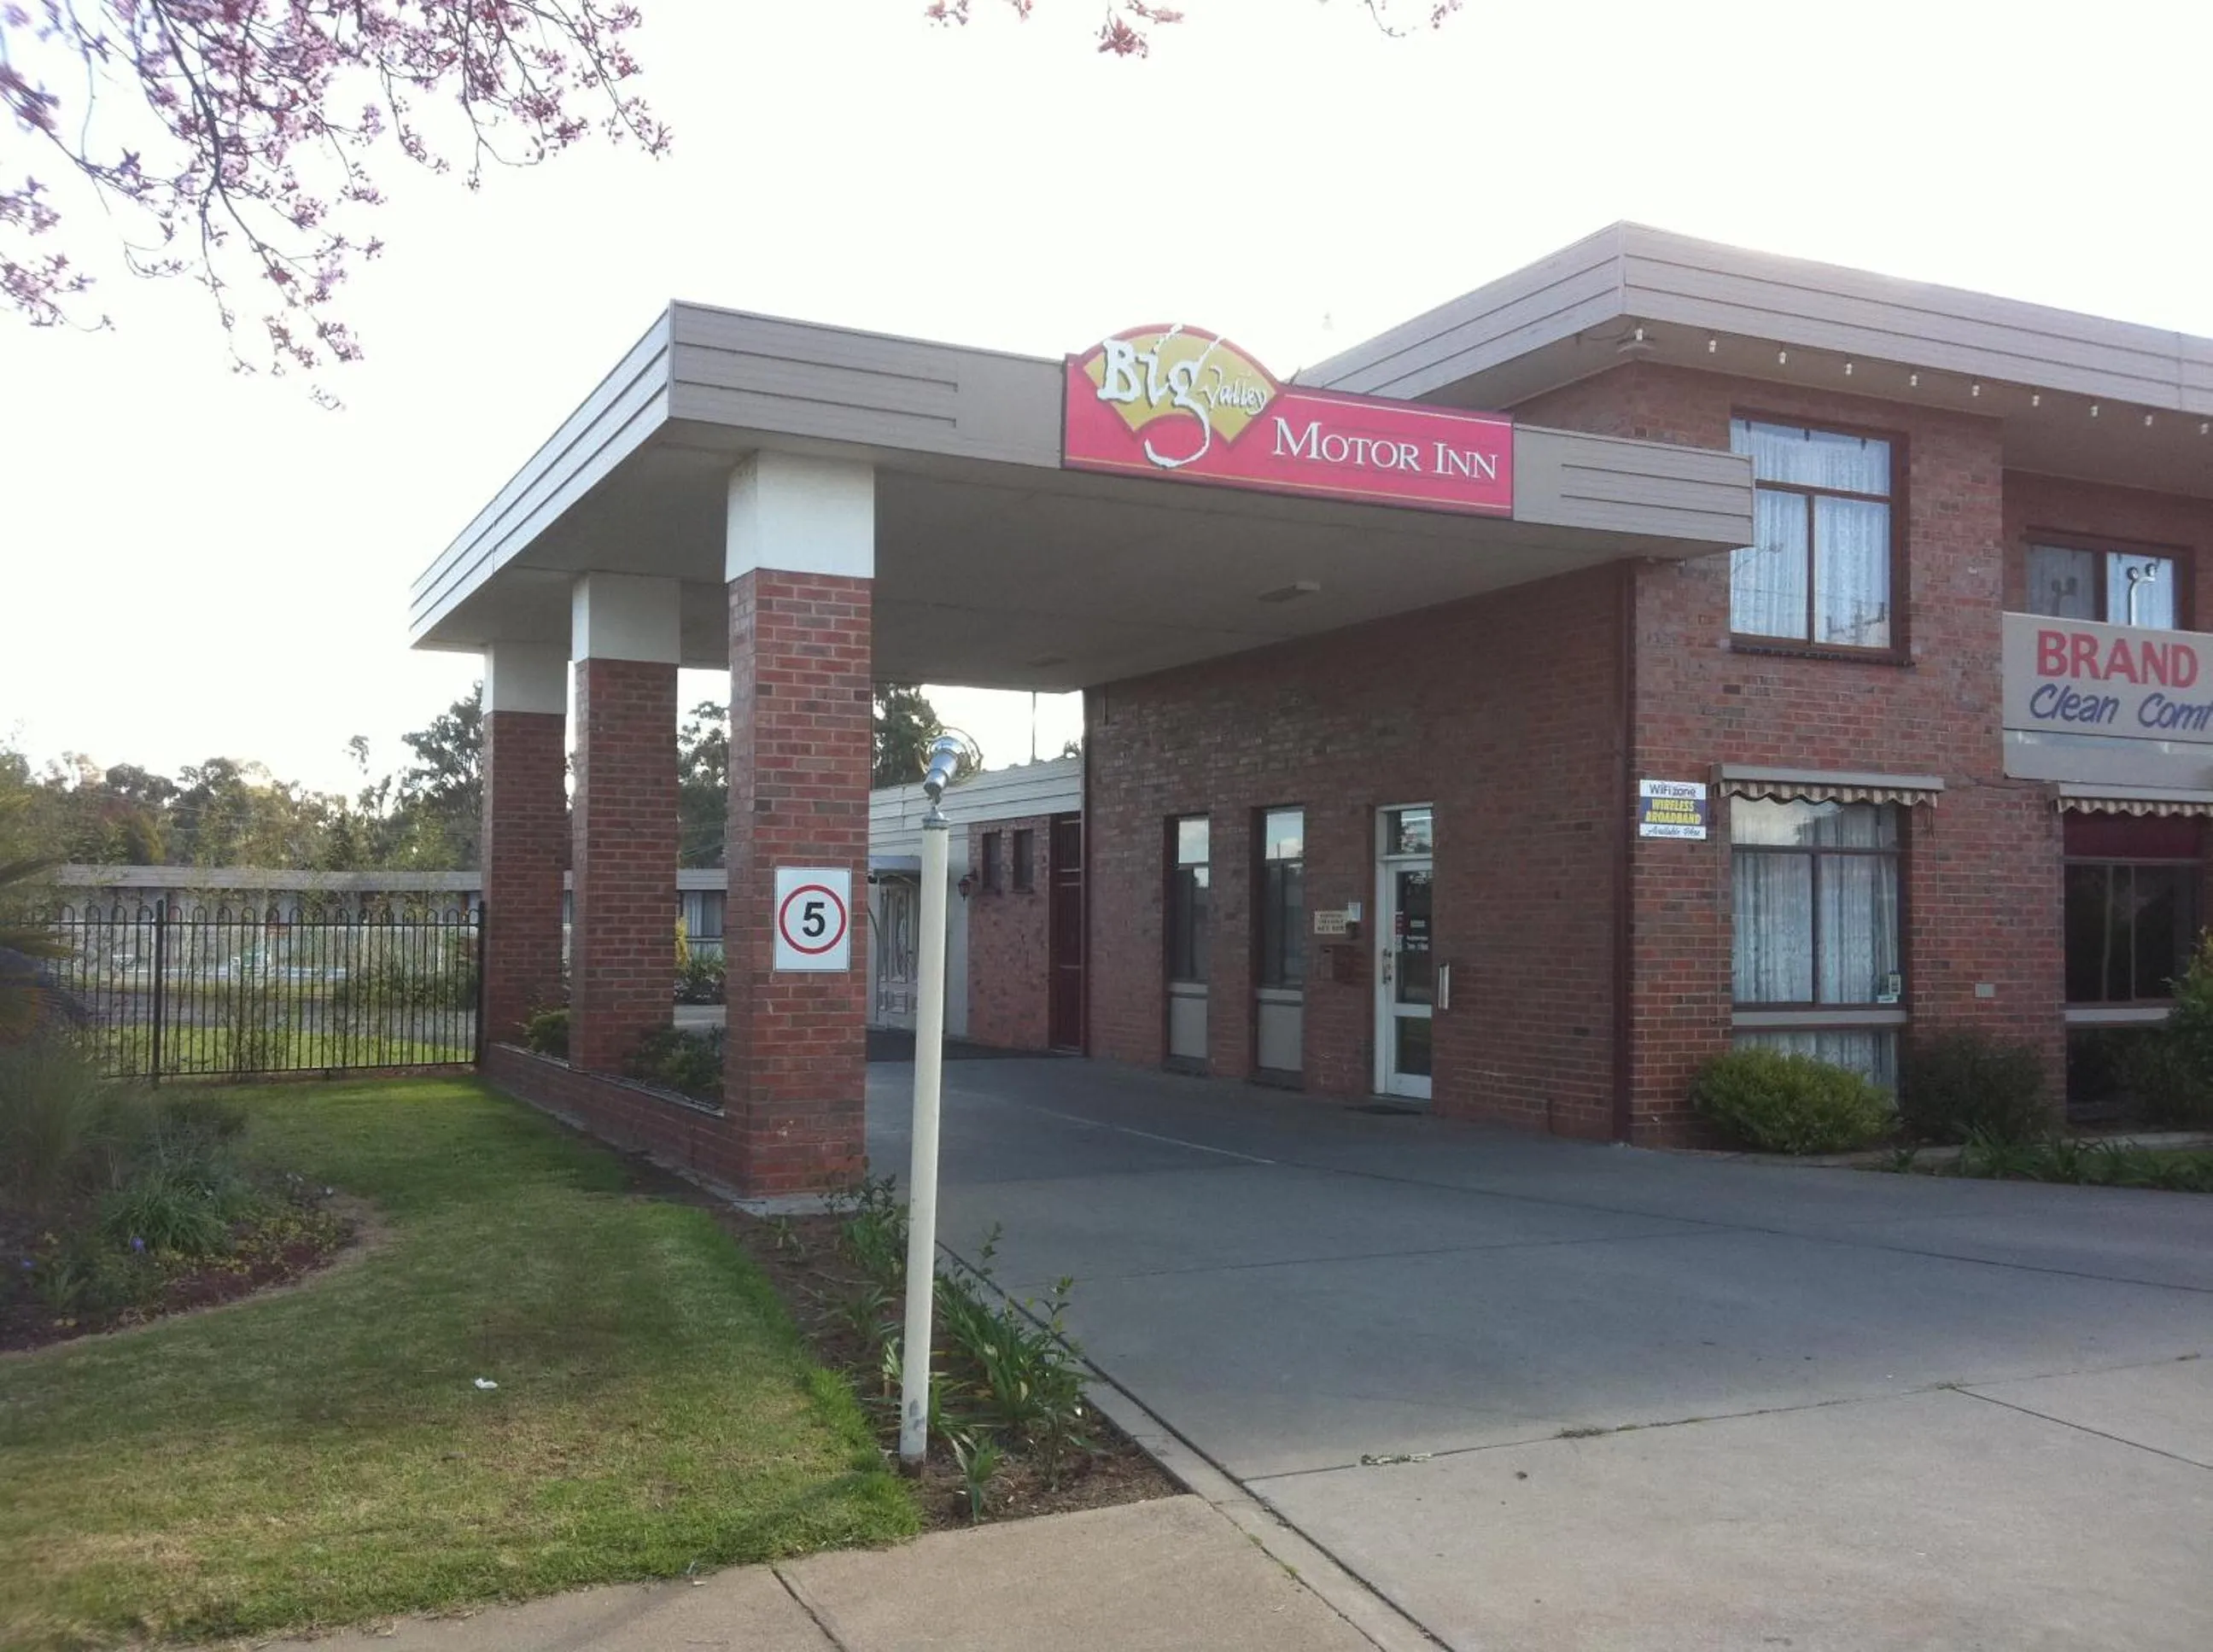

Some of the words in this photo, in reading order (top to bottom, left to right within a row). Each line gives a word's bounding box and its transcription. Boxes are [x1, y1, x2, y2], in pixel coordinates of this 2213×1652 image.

[1097, 324, 1223, 467] Big
[1198, 365, 1267, 417] Valley
[1271, 417, 1422, 472] MOTOR
[1433, 441, 1498, 480] INN
[2036, 629, 2198, 688] BRAND
[2029, 683, 2120, 724] Clean
[803, 902, 826, 937] 5
